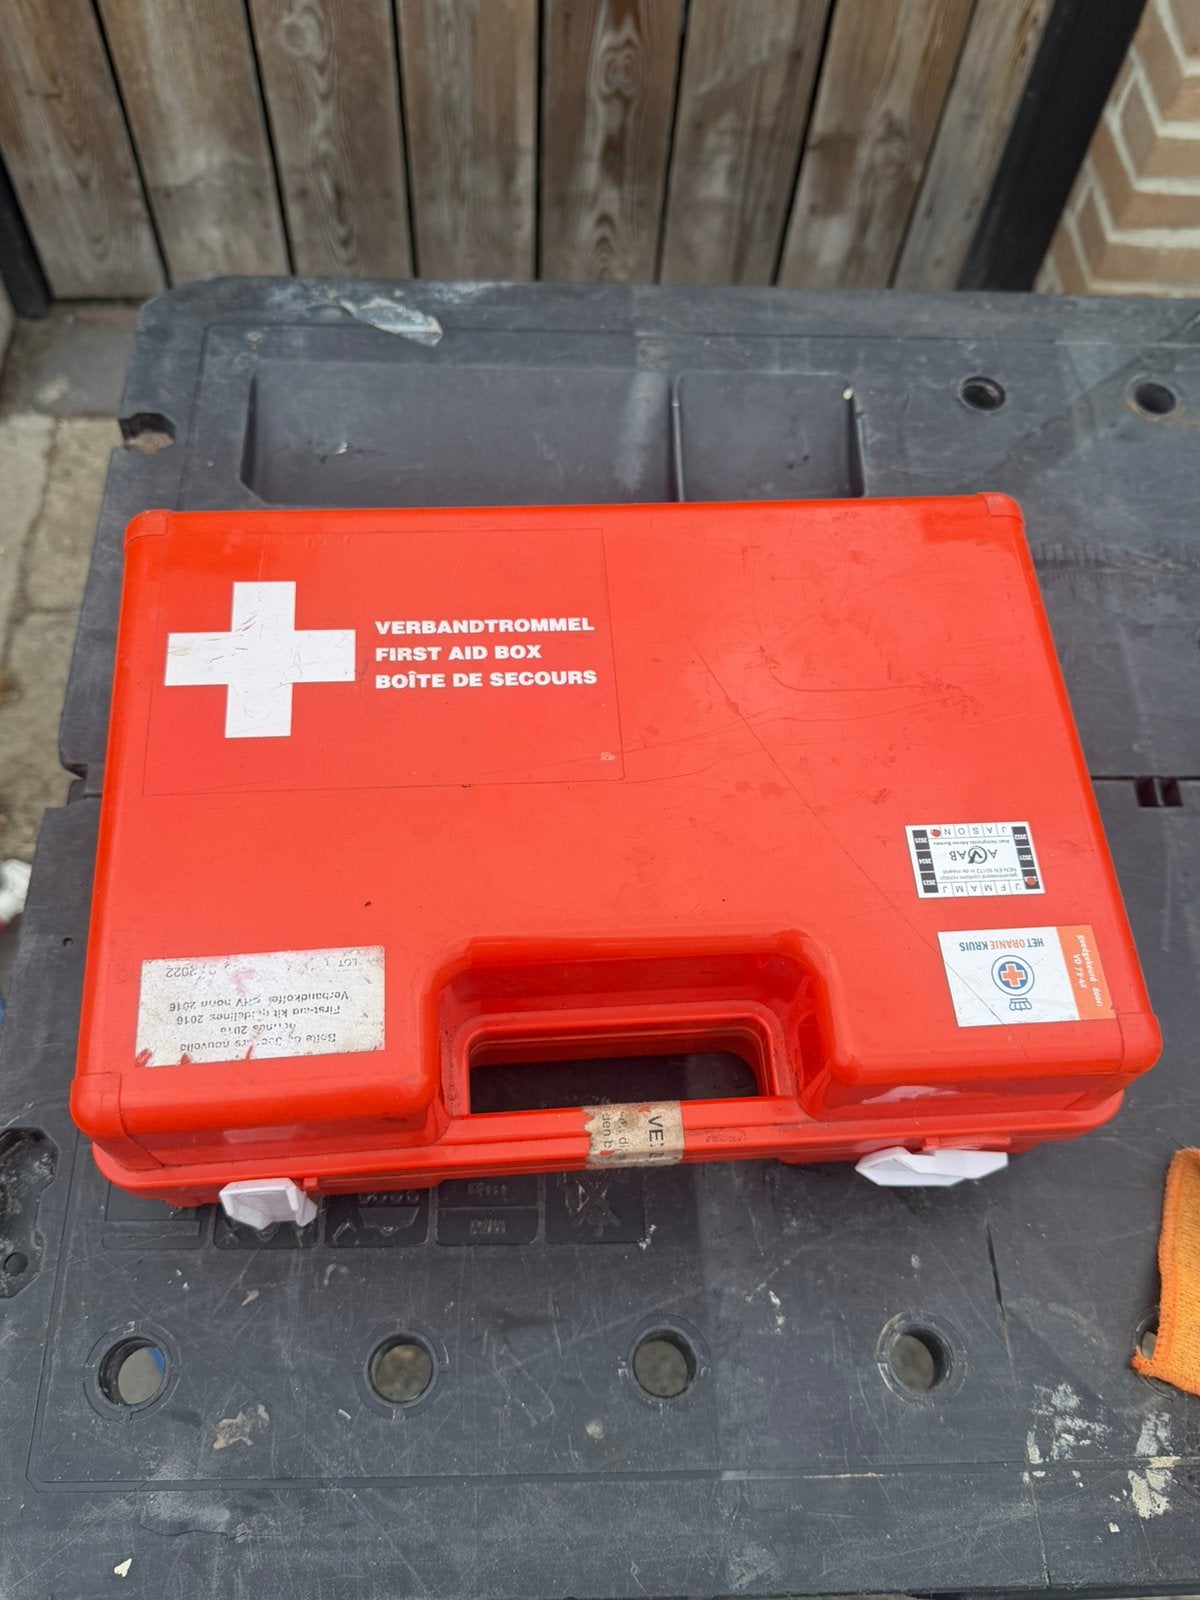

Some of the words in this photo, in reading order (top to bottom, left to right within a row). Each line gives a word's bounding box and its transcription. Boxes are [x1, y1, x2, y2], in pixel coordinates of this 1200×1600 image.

[375, 618, 594, 635] VERBANDTROMMEL
[375, 647, 442, 662] FIRST
[448, 646, 488, 660] AID
[495, 645, 542, 659] BOX
[375, 671, 446, 689] BOÎTE
[453, 673, 483, 687] DE
[490, 670, 597, 687] SECOURS
[959, 941, 988, 952] KRUIS
[989, 938, 1025, 950] ORANJE
[1027, 937, 1044, 948] HET
[273, 1008, 288, 1018] kit
[176, 1014, 204, 1025] 2016
